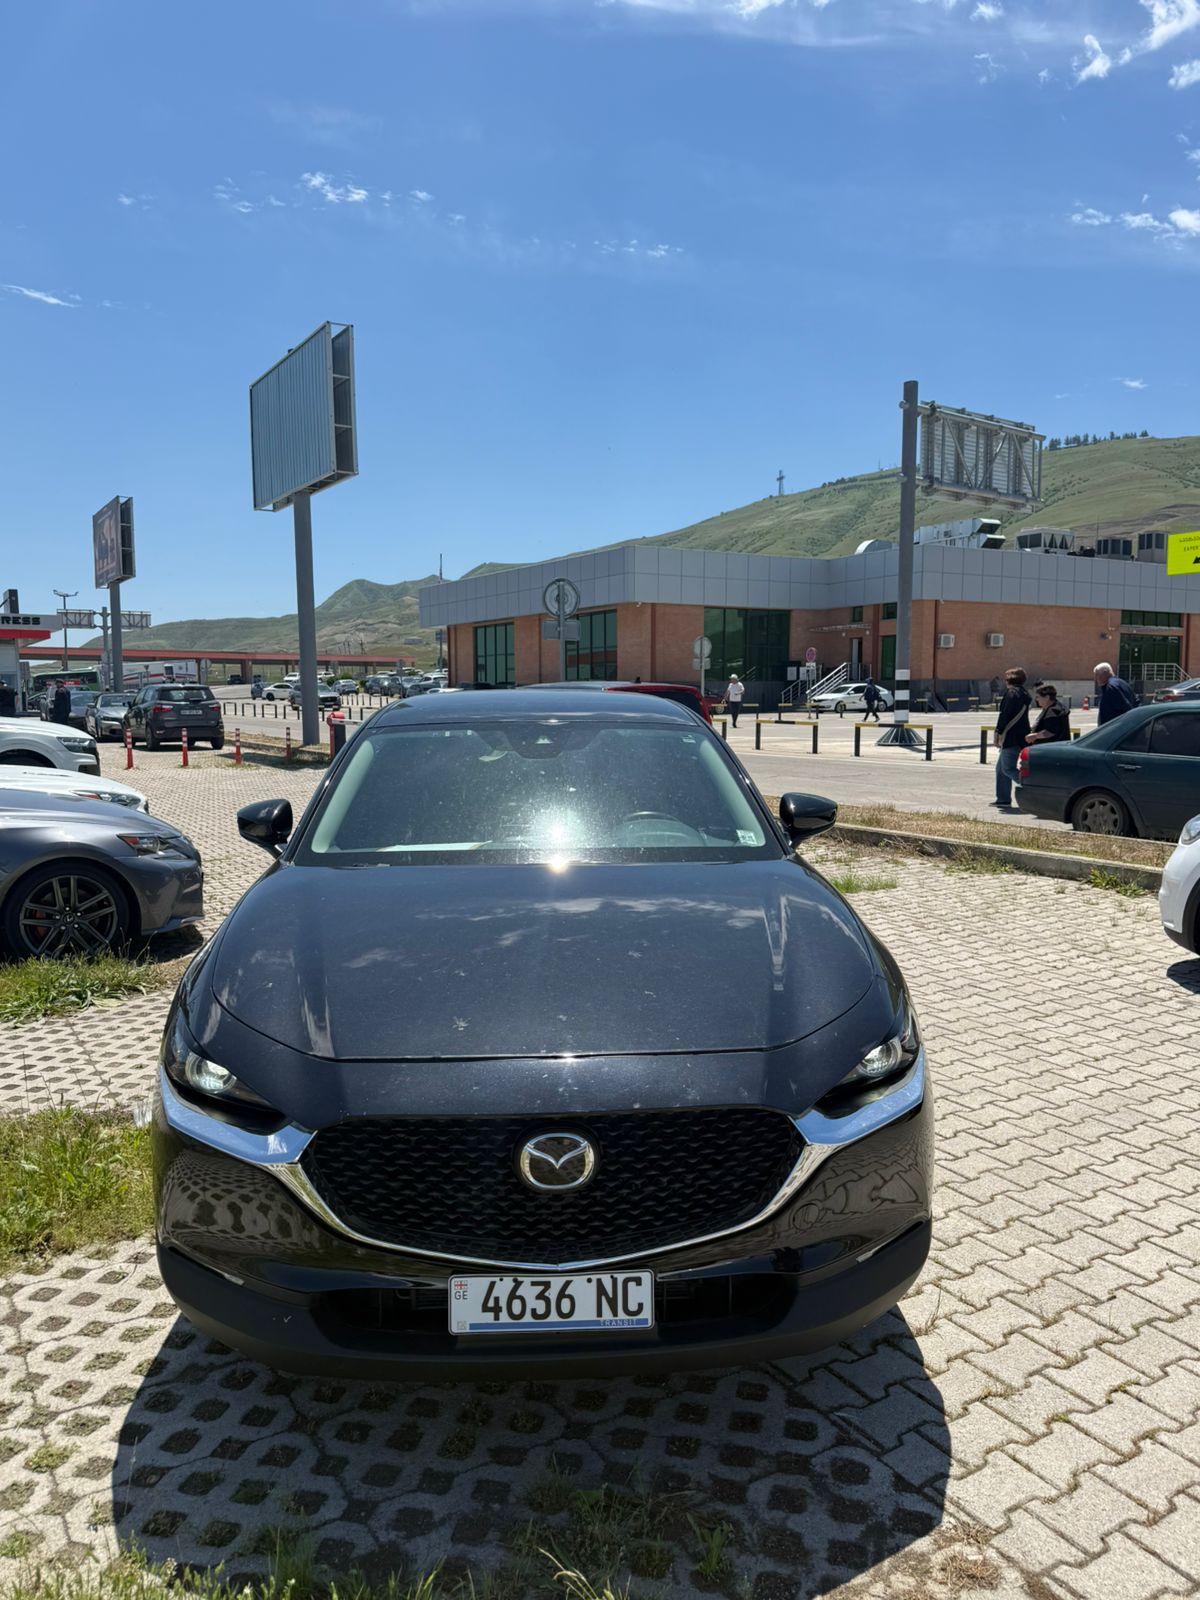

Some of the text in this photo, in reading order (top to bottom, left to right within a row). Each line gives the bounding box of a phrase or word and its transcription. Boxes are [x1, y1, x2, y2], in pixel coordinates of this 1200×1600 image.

[1, 616, 41, 625] RESS
[454, 1290, 468, 1300] GE
[481, 1276, 644, 1321] 4636 NC
[600, 1318, 637, 1327] TRANSIT
